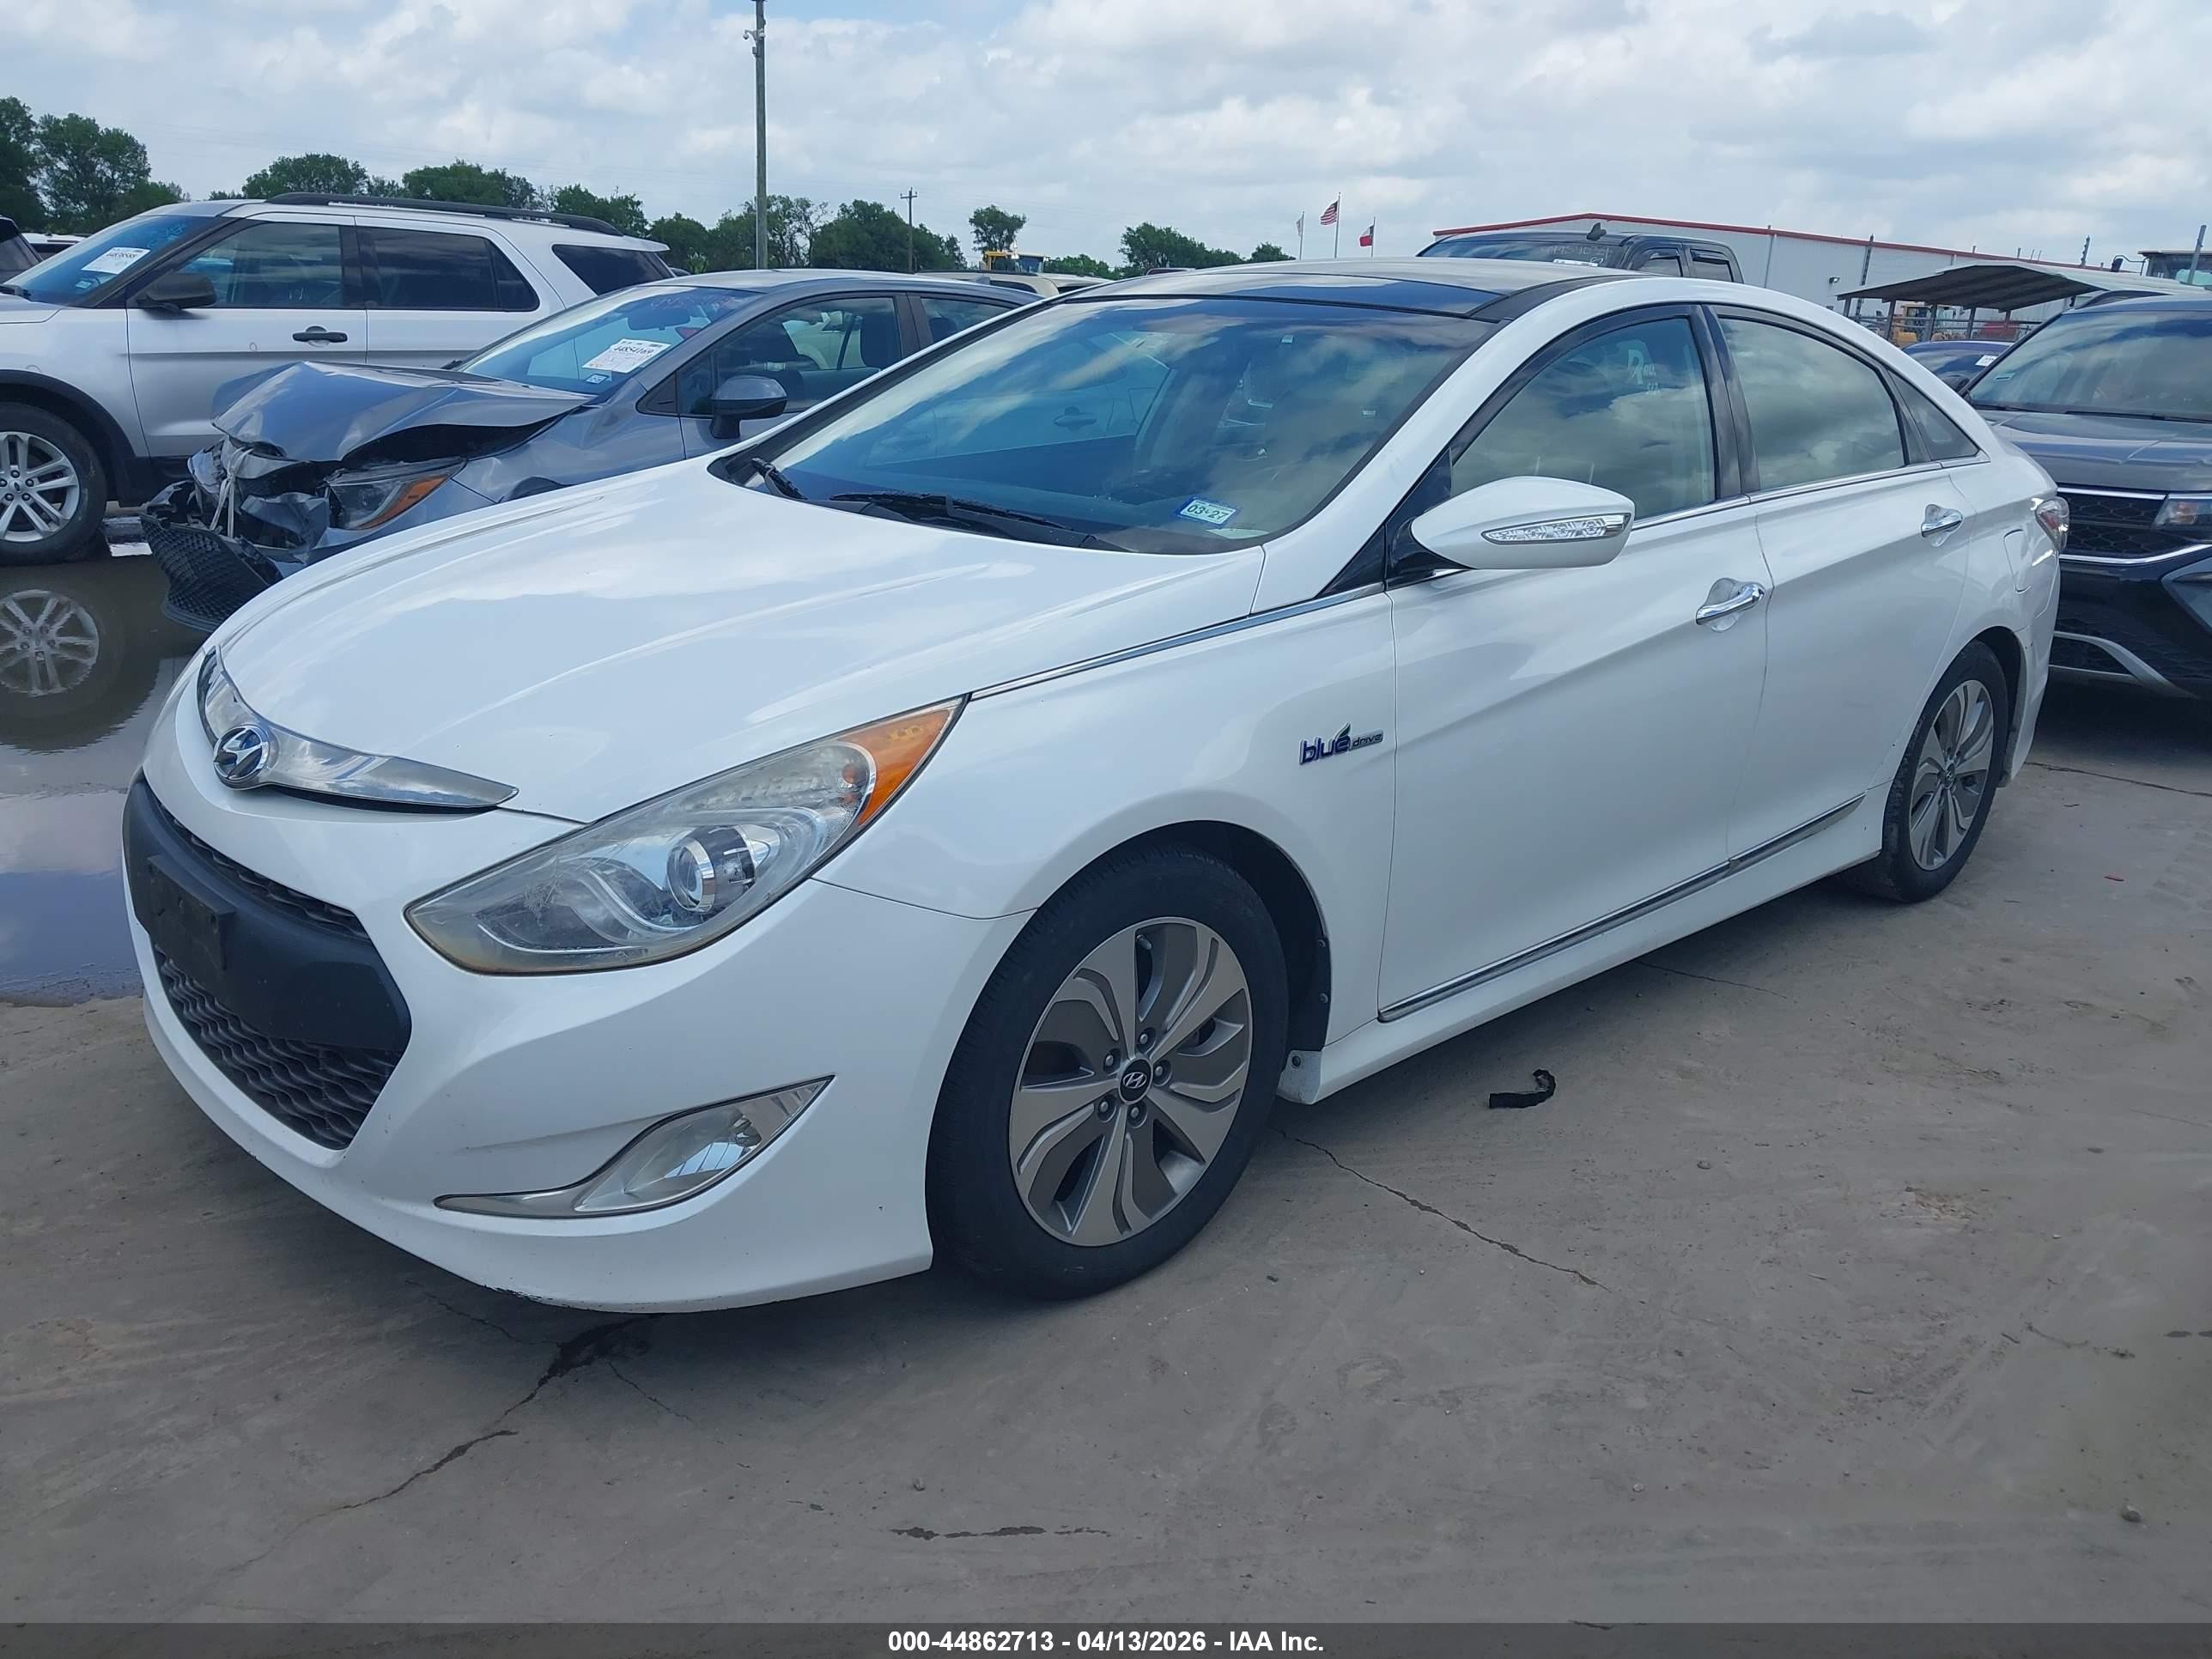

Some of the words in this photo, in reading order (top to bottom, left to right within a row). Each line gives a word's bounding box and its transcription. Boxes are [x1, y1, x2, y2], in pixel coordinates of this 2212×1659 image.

[1187, 504, 1206, 515] 03
[1207, 509, 1231, 520] 27
[1299, 731, 1351, 765] blue
[1352, 732, 1383, 749] drive
